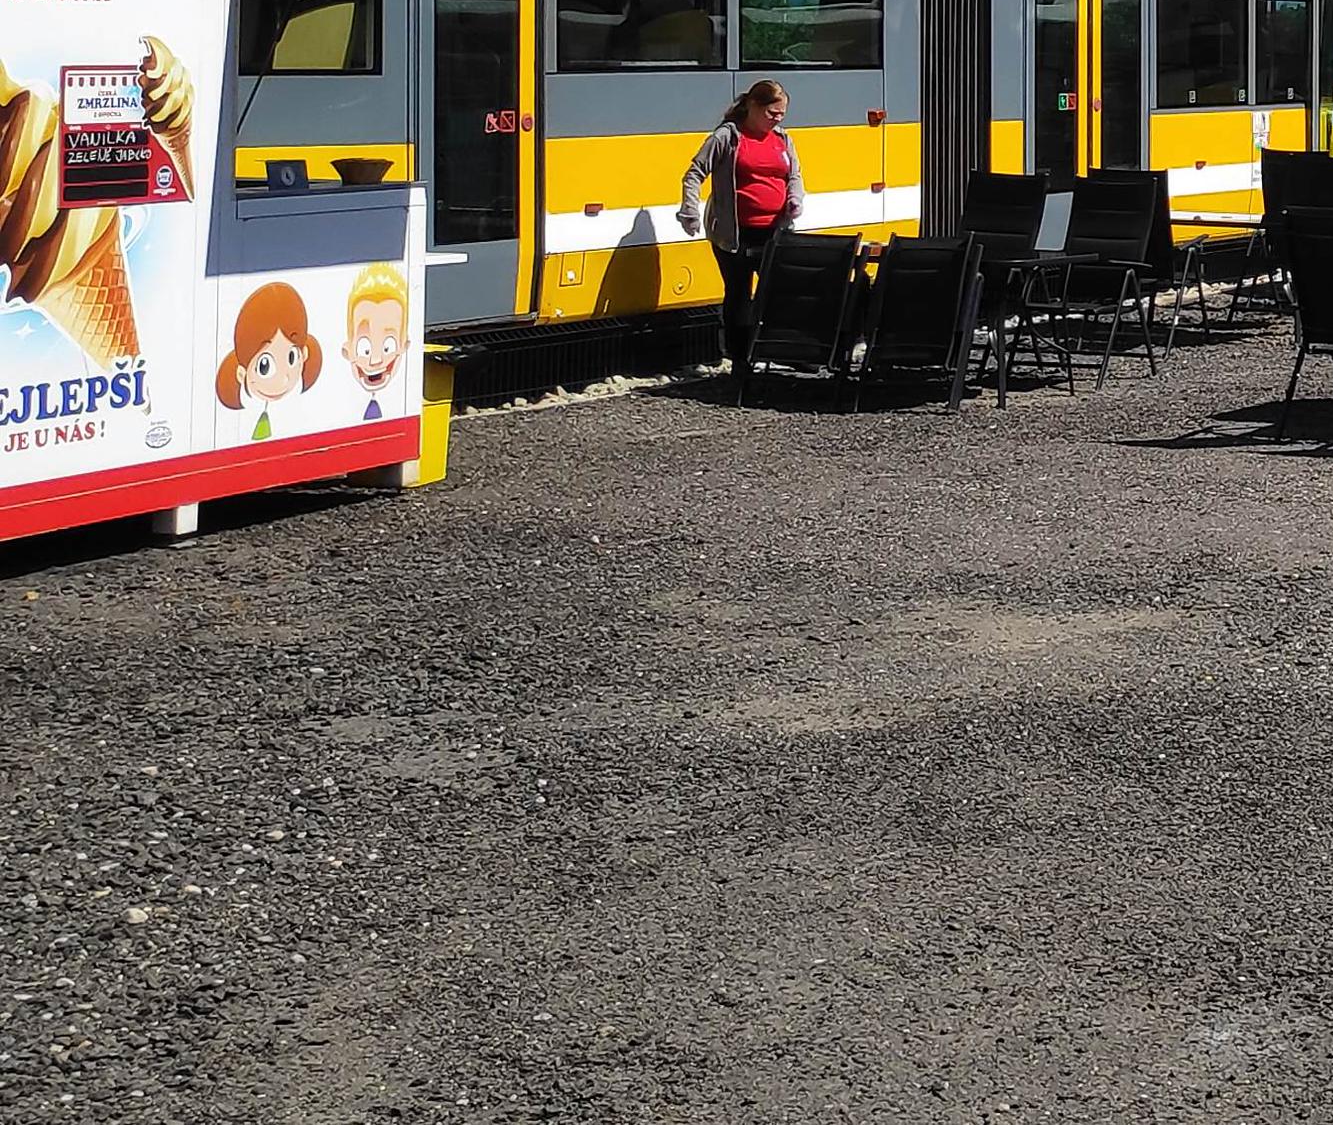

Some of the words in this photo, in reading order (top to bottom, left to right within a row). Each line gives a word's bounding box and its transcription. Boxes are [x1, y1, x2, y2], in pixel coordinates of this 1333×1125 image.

[77, 97, 138, 109] ZMRZLINA
[68, 131, 136, 149] VANILKA
[4, 432, 29, 452] JE
[35, 429, 49, 447] U
